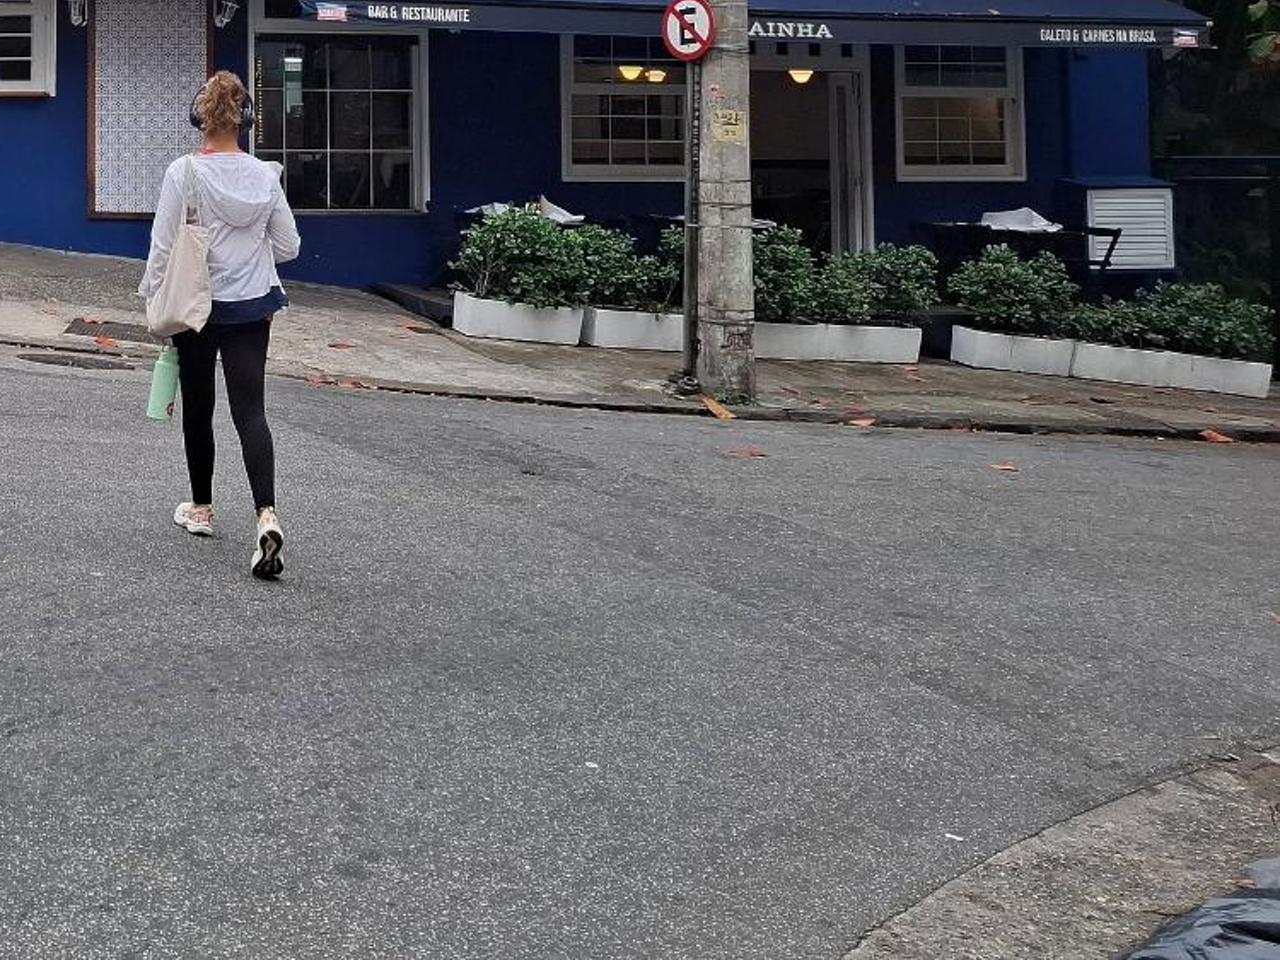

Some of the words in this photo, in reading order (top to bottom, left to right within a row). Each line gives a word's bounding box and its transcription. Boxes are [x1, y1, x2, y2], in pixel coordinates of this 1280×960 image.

[367, 5, 389, 19] BAR
[401, 6, 471, 22] RESTAURANTE
[748, 21, 834, 39] AINHA
